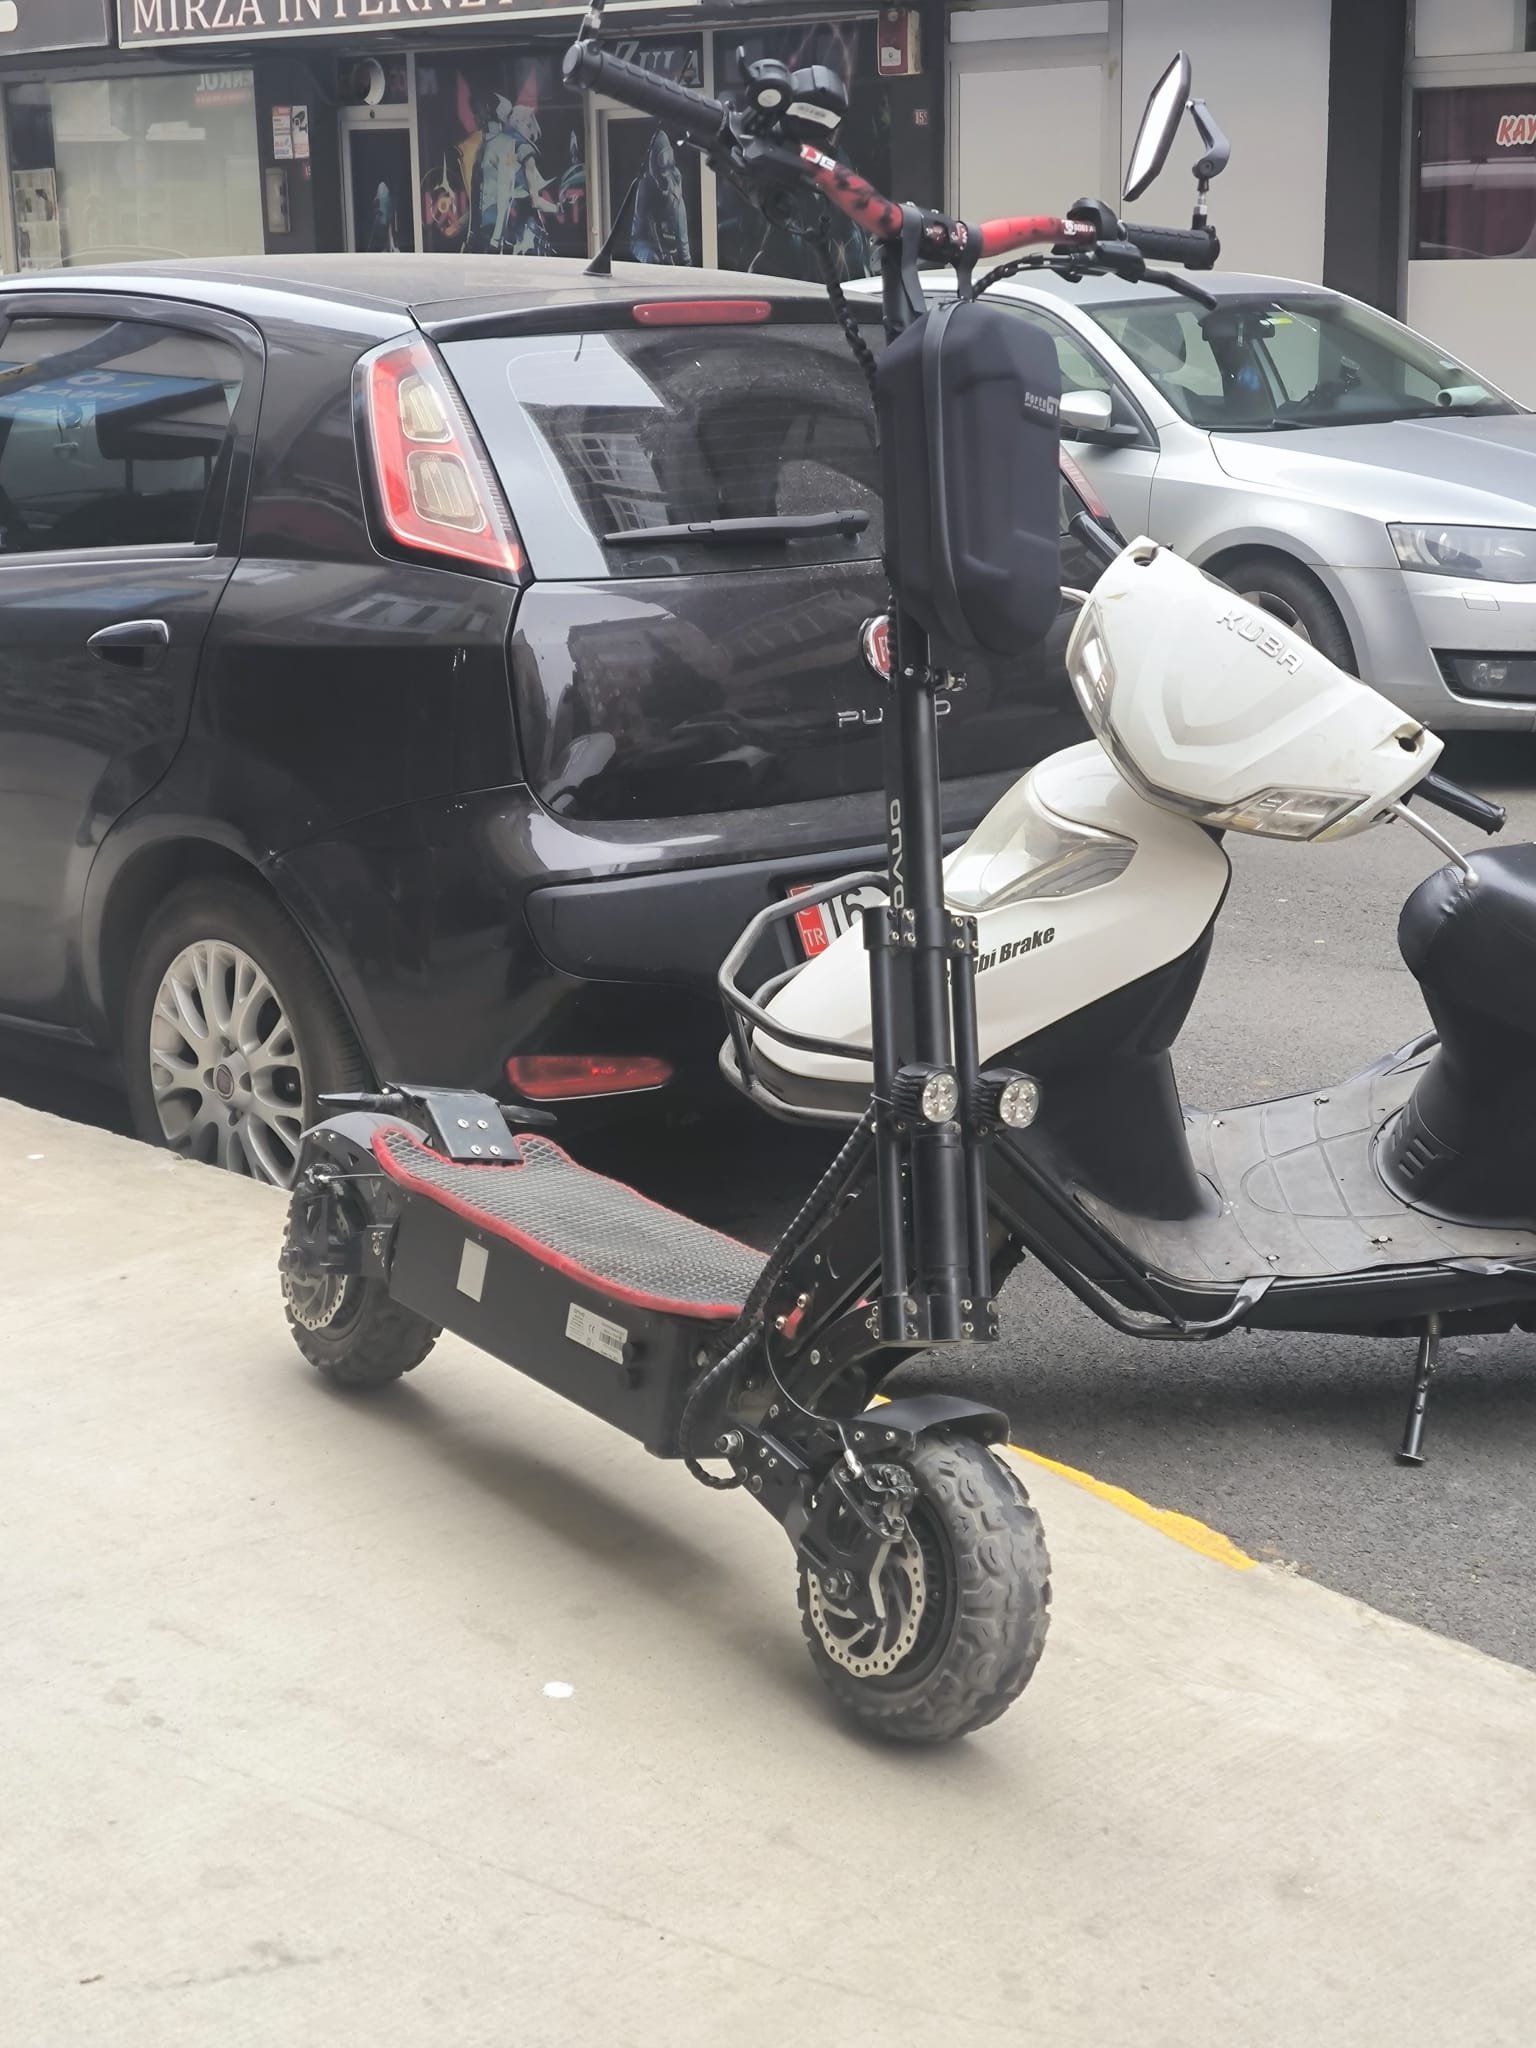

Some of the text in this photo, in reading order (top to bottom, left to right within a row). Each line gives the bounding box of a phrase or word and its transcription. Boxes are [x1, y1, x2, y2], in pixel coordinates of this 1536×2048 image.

[133, 0, 266, 33] MIRZA
[1216, 610, 1304, 676] KUBA
[837, 700, 951, 728] PUO
[803, 928, 826, 947] TR
[999, 927, 1055, 964] Brake
